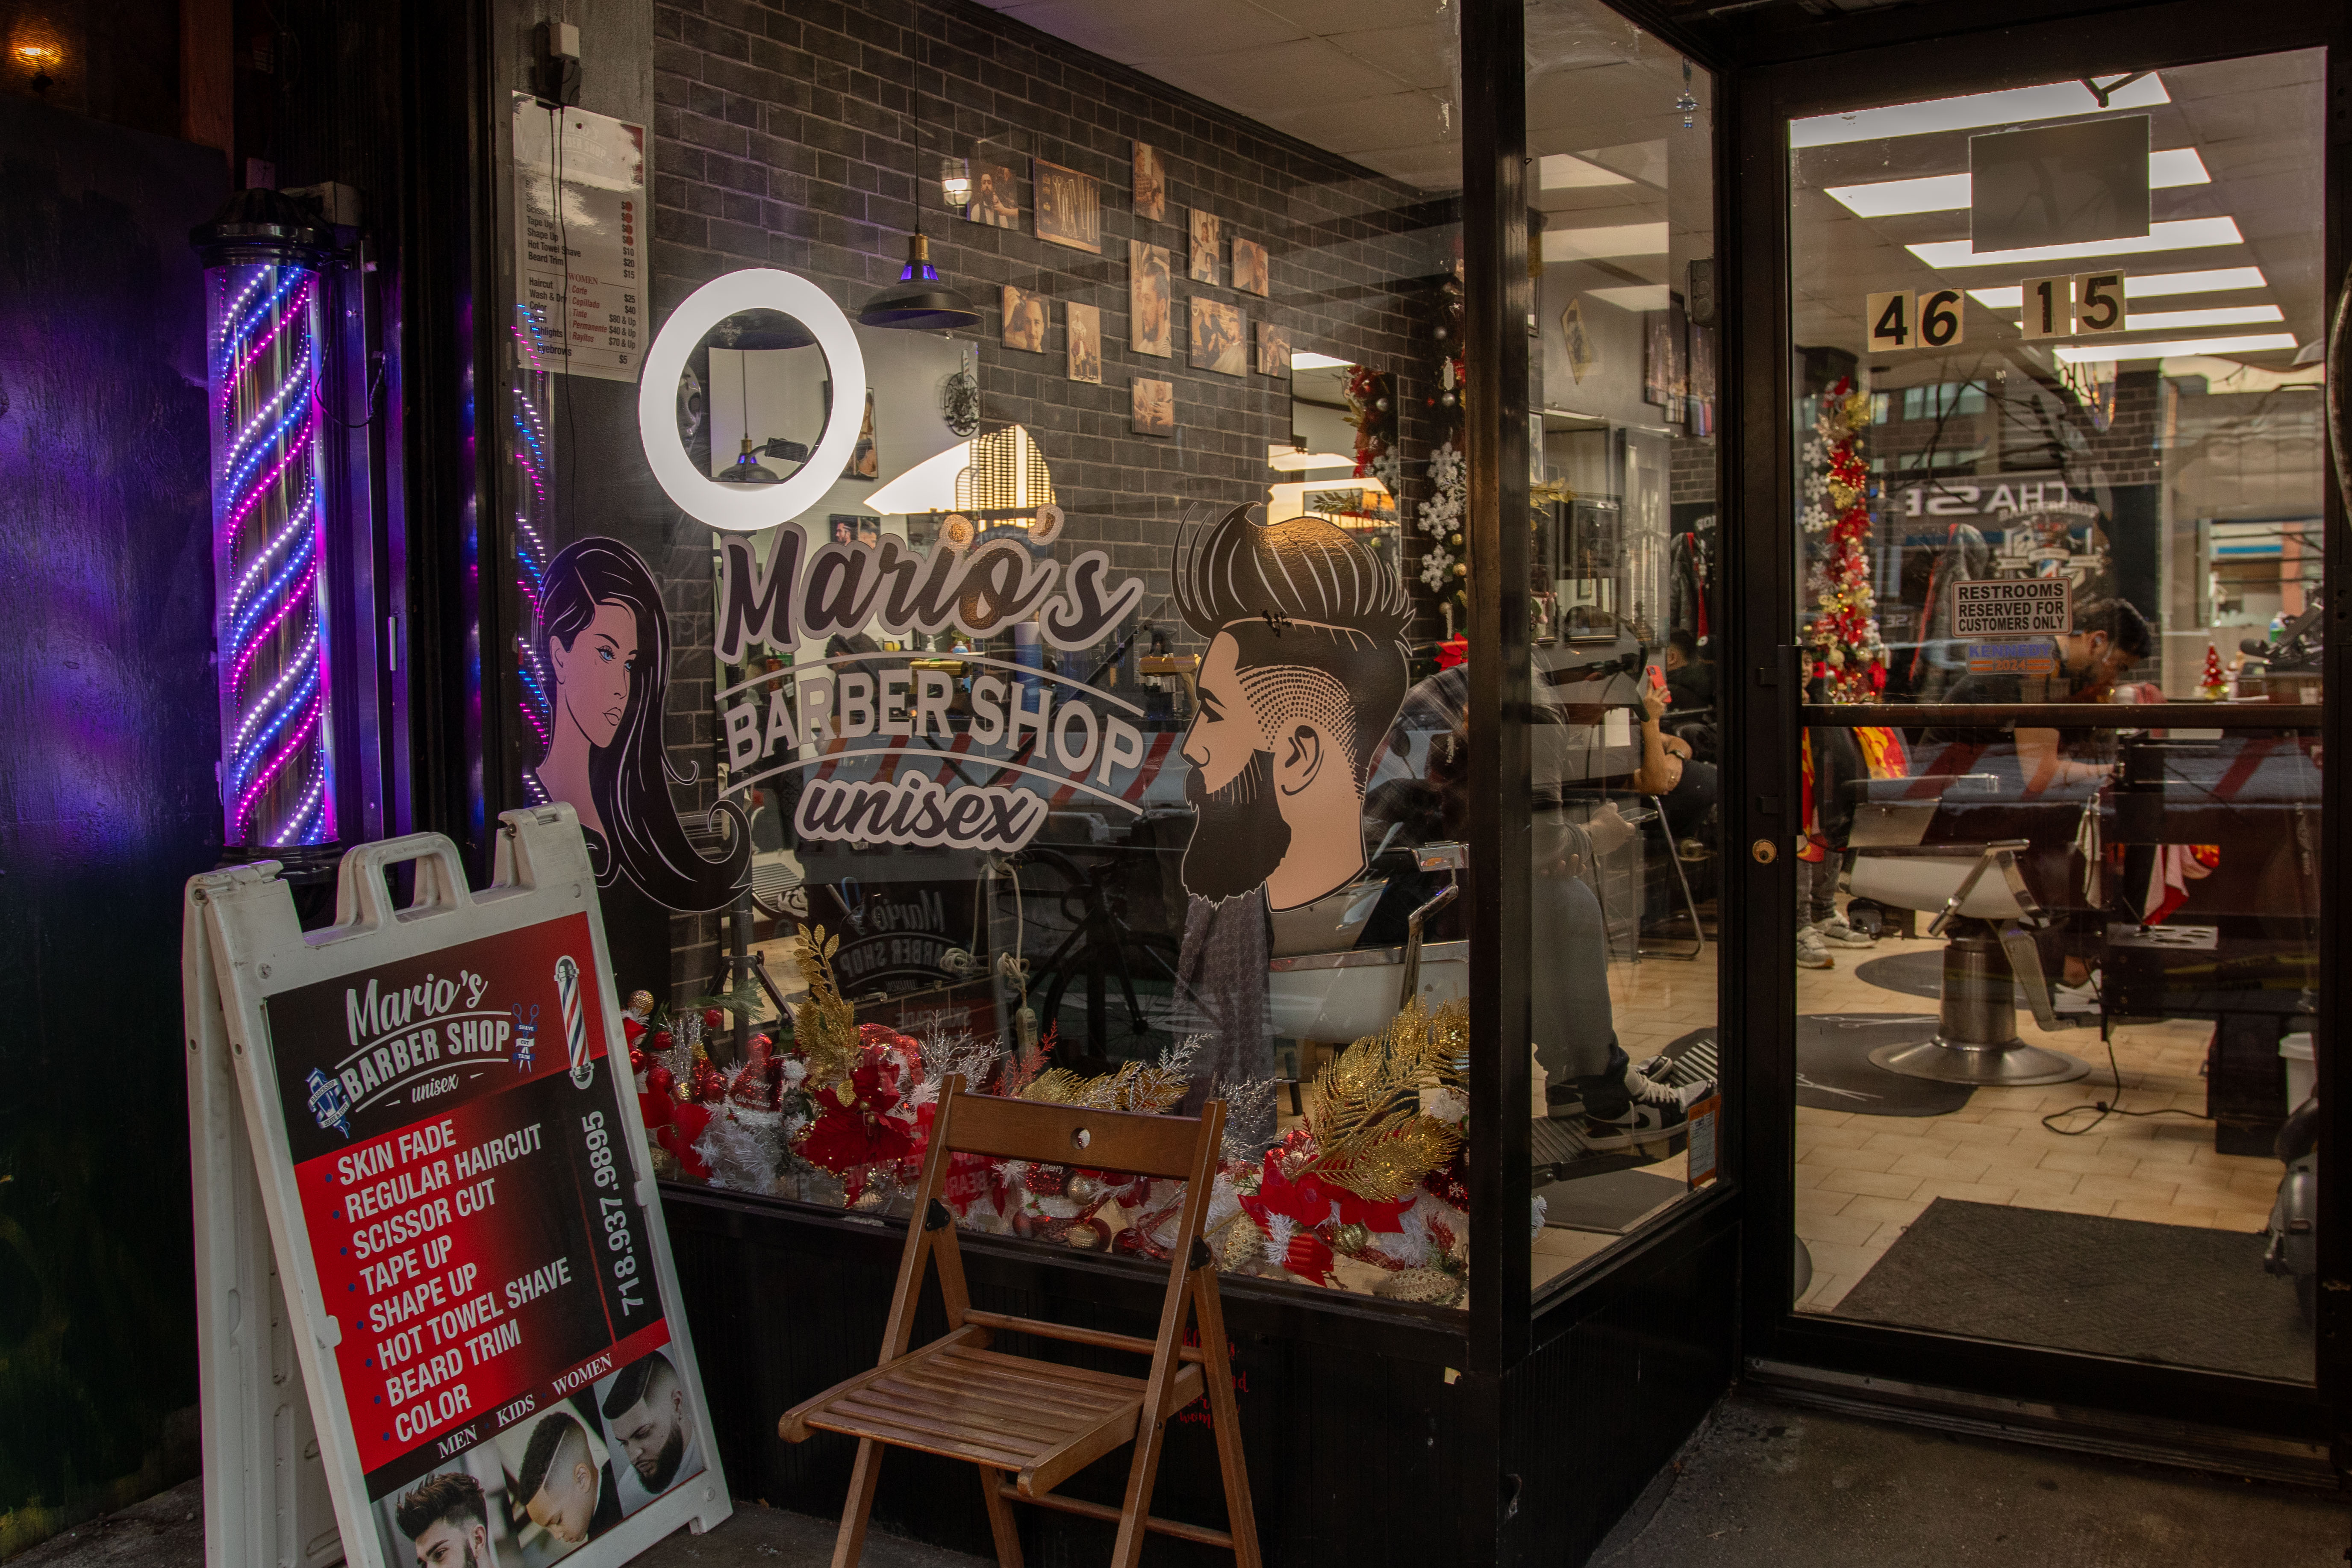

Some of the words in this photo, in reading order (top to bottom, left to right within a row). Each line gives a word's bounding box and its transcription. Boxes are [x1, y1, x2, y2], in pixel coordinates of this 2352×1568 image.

[527, 215, 542, 227] Tape
[545, 219, 553, 229] Up
[527, 227, 548, 240] Shape
[550, 232, 559, 243] Up
[528, 239, 539, 250] Hot
[541, 242, 559, 253] Towel
[562, 246, 581, 257] Shave
[528, 251, 548, 263] Beard
[549, 255, 564, 266] Trim
[623, 247, 634, 256] $10
[623, 258, 635, 268] $20
[624, 269, 635, 279] $15
[529, 277, 553, 289] Haircut
[572, 285, 587, 295] Corte
[624, 294, 636, 303] $25
[568, 273, 598, 285] WOMEN
[529, 289, 548, 300] Wash
[549, 293, 554, 301] &
[572, 297, 600, 309] Cepillado
[625, 305, 636, 315] $40
[530, 301, 547, 311] Color
[573, 309, 587, 318] Tinte
[609, 314, 620, 324] $80
[622, 316, 627, 324] &
[628, 317, 636, 327] Up
[1874, 291, 1960, 346] 46
[2037, 275, 2119, 333] 15
[530, 313, 547, 323] Perm
[573, 321, 607, 333] Permanente
[609, 326, 620, 335] $40
[622, 327, 627, 335] &
[628, 329, 636, 338] Up
[537, 344, 572, 356] Eyebrows
[619, 354, 627, 364] $5
[572, 332, 594, 342] Rayitos
[609, 337, 620, 347] $70
[621, 339, 627, 347] &
[628, 340, 636, 350] Up
[714, 503, 1145, 664] Mario's
[1959, 583, 2064, 600] RESTROOMS
[1959, 602, 2031, 617] RESERVED
[2036, 600, 2064, 615] FOR
[1959, 617, 2029, 632] CUSTOMERS
[2033, 615, 2064, 629] ONLY
[1969, 644, 2051, 657] KENNEDY
[1996, 659, 2026, 671] 2024
[724, 669, 954, 774] BARBER
[968, 675, 1144, 788] SHOP
[795, 770, 1048, 852] unisex
[345, 970, 488, 1046] Mario's
[341, 1029, 440, 1103] BARBER
[447, 1020, 510, 1055] SHOP
[311, 1080, 335, 1103] BARBERSHOP
[412, 1074, 459, 1103] unisex
[745, 1078, 772, 1090] Merry
[324, 1115, 336, 1127] SHAVE
[339, 1104, 349, 1115] CUTS
[338, 1141, 395, 1185] SKIN
[398, 1119, 457, 1163] FADE
[344, 1160, 449, 1223] REGULAR
[453, 1123, 542, 1181] HAIRCUT
[353, 1197, 451, 1260] SCISSOR
[456, 1178, 496, 1217] CUT
[582, 1110, 644, 1316] 718.937.9895
[359, 1248, 417, 1296] TAPE
[424, 1235, 453, 1268] UP
[369, 1285, 446, 1333] SHAPE
[448, 1262, 477, 1296] UP
[377, 1327, 423, 1370] HOT
[427, 1291, 503, 1347] TOWEL
[505, 1257, 571, 1309] SHAVE
[385, 1354, 463, 1407] BEARD
[465, 1318, 522, 1367] TRIM
[395, 1383, 472, 1442] COLOR
[437, 1424, 478, 1459] MEN
[496, 1394, 536, 1427] KIDS
[551, 1353, 612, 1395] WOMEN
